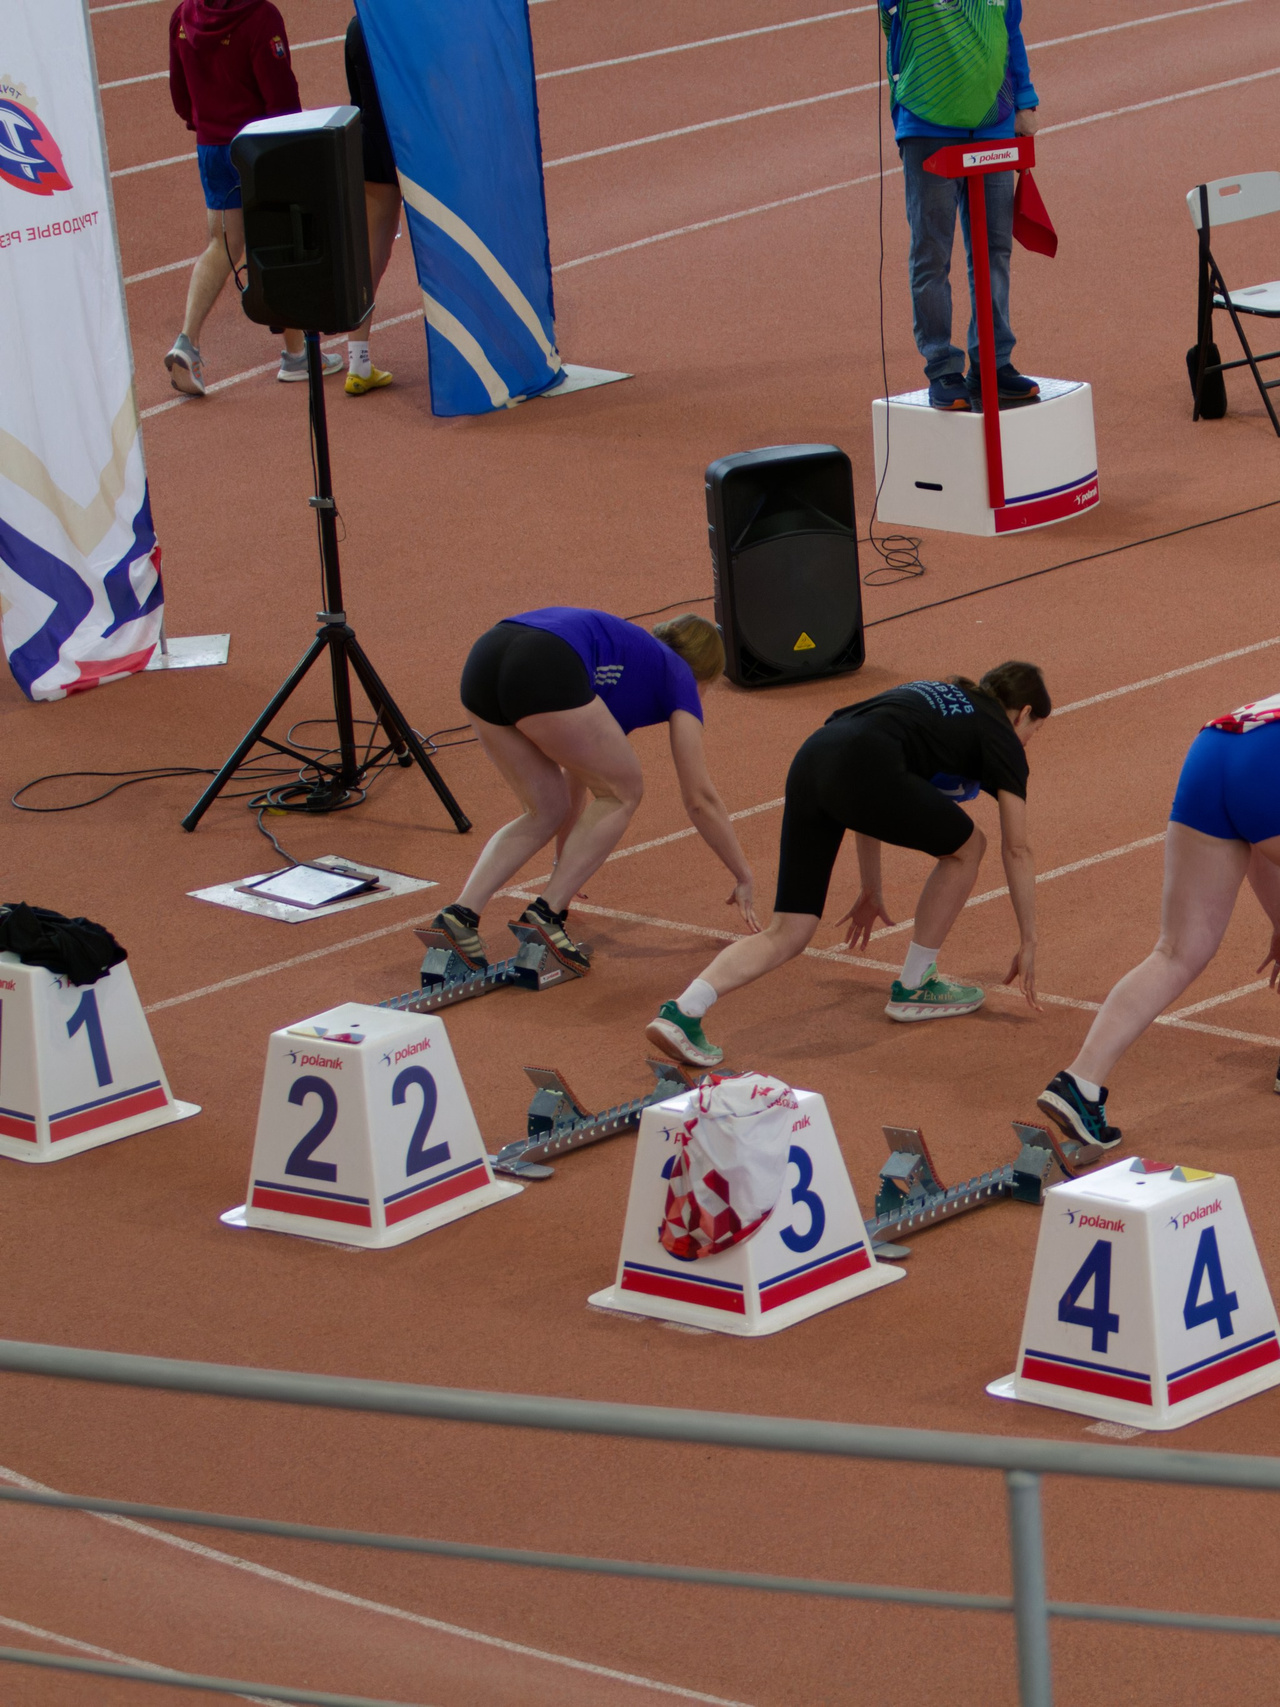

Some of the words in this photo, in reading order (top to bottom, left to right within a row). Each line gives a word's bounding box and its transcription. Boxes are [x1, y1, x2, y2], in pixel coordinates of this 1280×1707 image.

[979, 150, 1012, 163] polanik
[66, 988, 113, 1087] 1
[300, 1053, 343, 1070] polanik
[394, 1037, 431, 1065] polanik
[284, 1075, 339, 1183] 2
[392, 1065, 451, 1178] 2
[779, 1145, 826, 1253] 3
[1078, 1213, 1126, 1233] polanik
[1182, 1198, 1223, 1229] polanik
[1058, 1239, 1119, 1354] 4
[1183, 1225, 1239, 1340] 4
